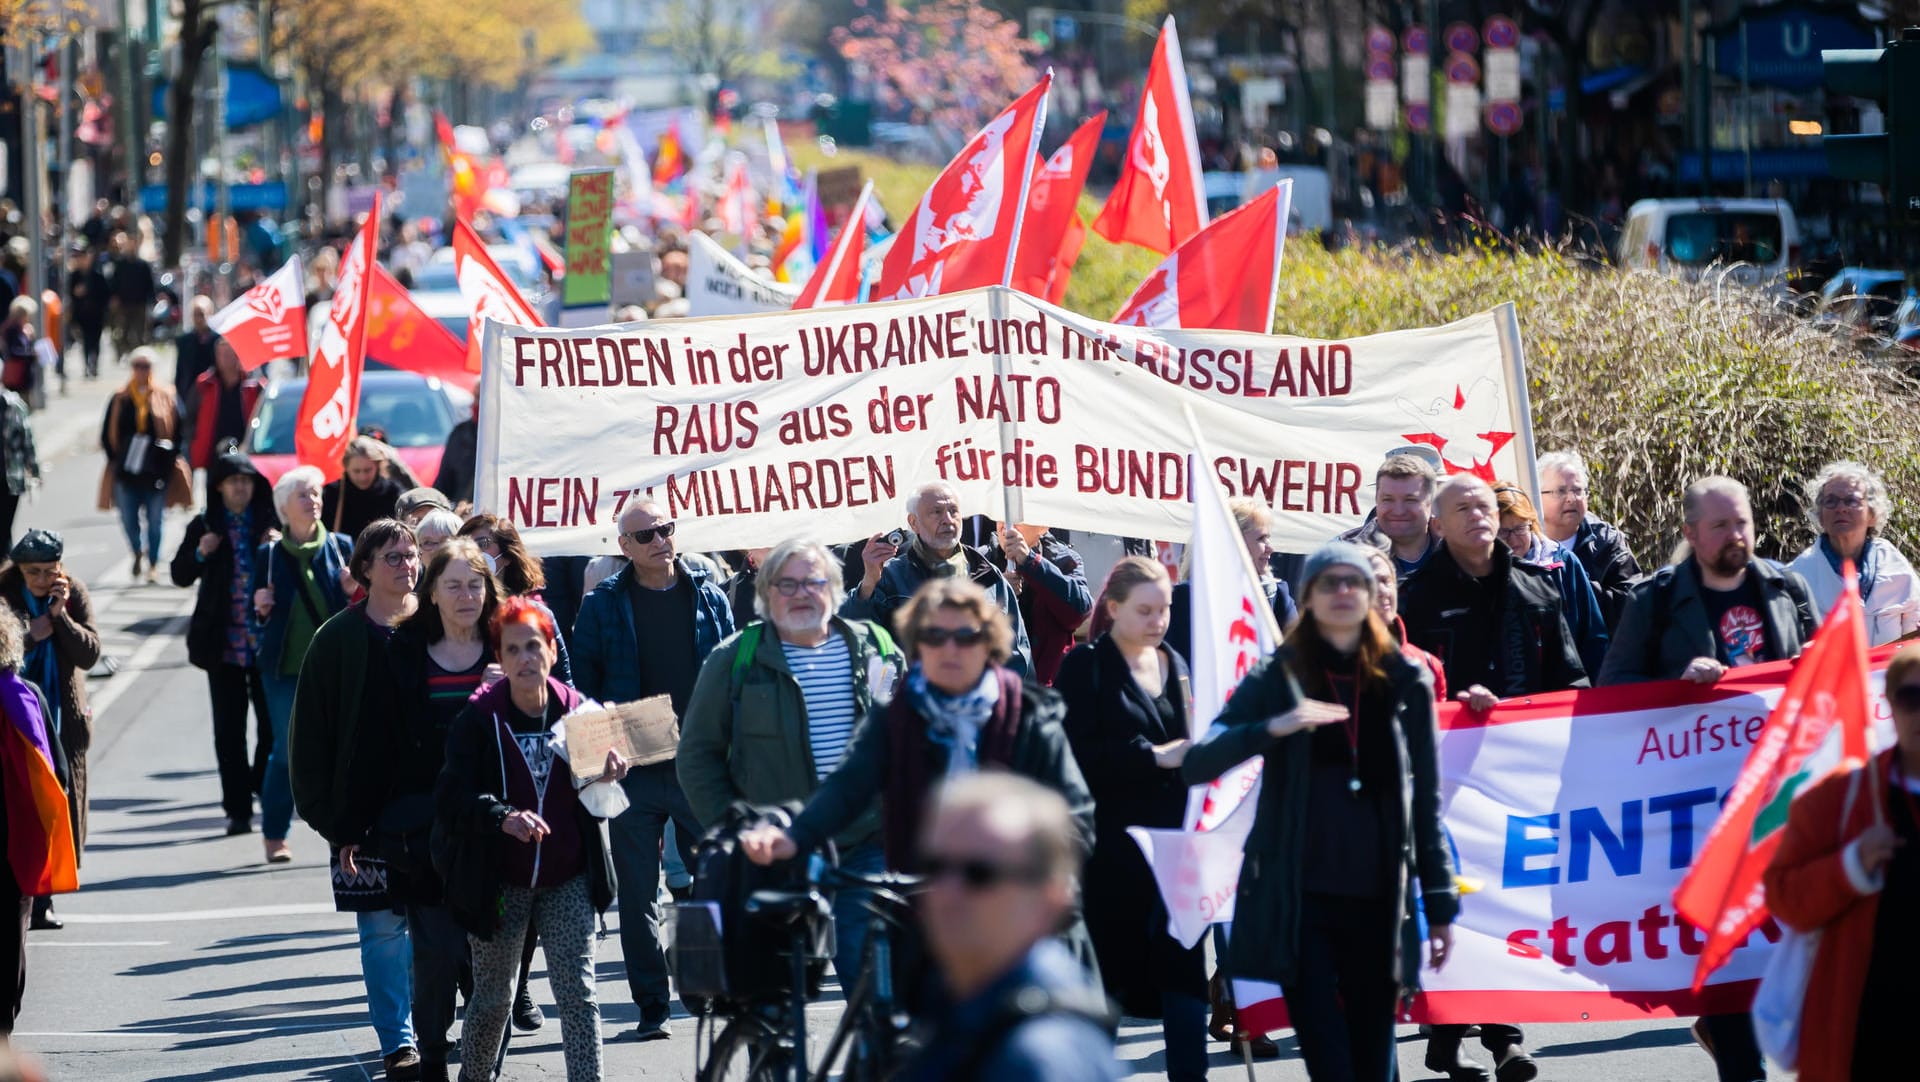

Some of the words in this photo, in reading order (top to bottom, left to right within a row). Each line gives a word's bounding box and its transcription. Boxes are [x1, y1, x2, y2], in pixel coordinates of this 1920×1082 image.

[1783, 20, 1810, 57] U
[514, 336, 675, 387] FRIEDEN
[684, 336, 721, 385] in
[728, 332, 790, 383] der
[800, 309, 969, 377] UKRAINE
[977, 310, 1048, 356] und
[1135, 339, 1353, 398] RUSSLAND
[653, 400, 759, 456] RAUS
[778, 403, 853, 446] aus
[867, 385, 934, 435] der
[955, 374, 1061, 425] NATO
[508, 476, 599, 528] NEIN
[666, 455, 896, 519] MILLIARDEN
[935, 438, 996, 482] für
[1002, 438, 1059, 489] die
[1502, 784, 1736, 889] ENT
